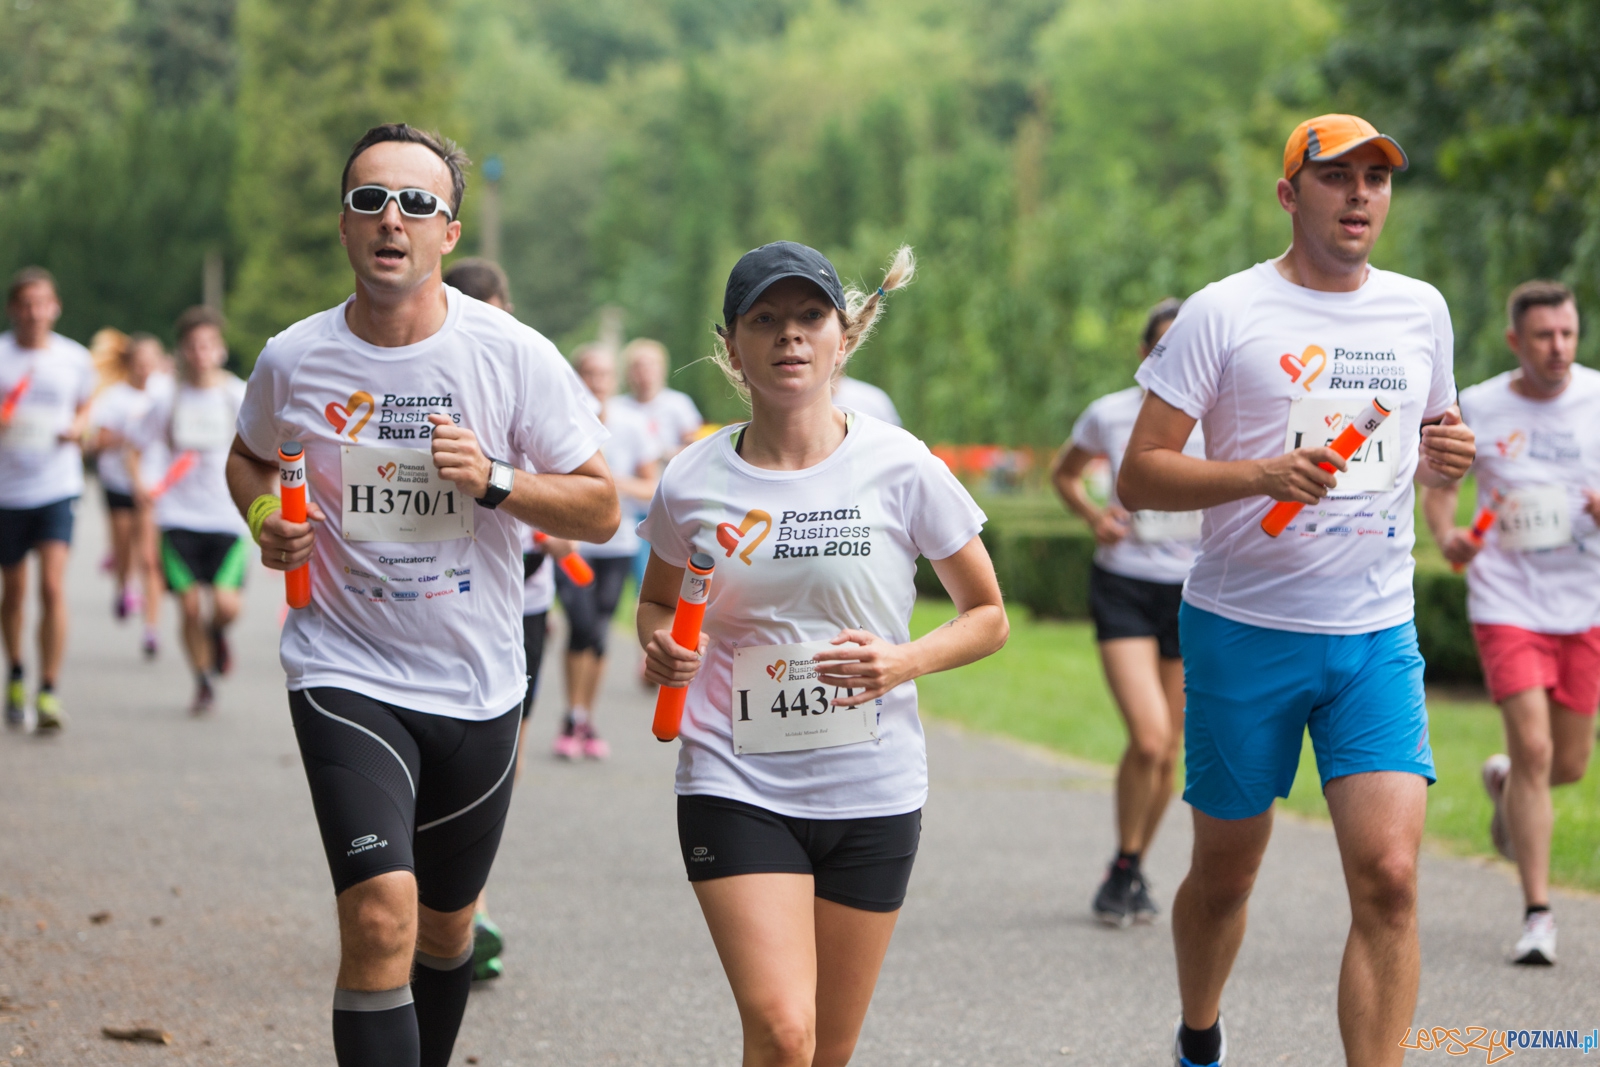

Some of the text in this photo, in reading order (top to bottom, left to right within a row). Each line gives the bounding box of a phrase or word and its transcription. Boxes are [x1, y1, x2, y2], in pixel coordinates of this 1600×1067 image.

[1333, 348, 1396, 361] Poznań
[1332, 362, 1405, 376] Business
[1329, 377, 1408, 390] Run 2016
[381, 393, 453, 407] Poznań
[377, 426, 415, 439] Run
[280, 467, 303, 482] 370
[780, 505, 862, 524] Poznań
[776, 523, 871, 542] Business
[772, 541, 871, 559] Run 2016
[378, 556, 437, 565] Organizatorzy:
[417, 574, 440, 583] ciber
[788, 671, 822, 681] Run 201
[737, 685, 859, 722] I 443/1
